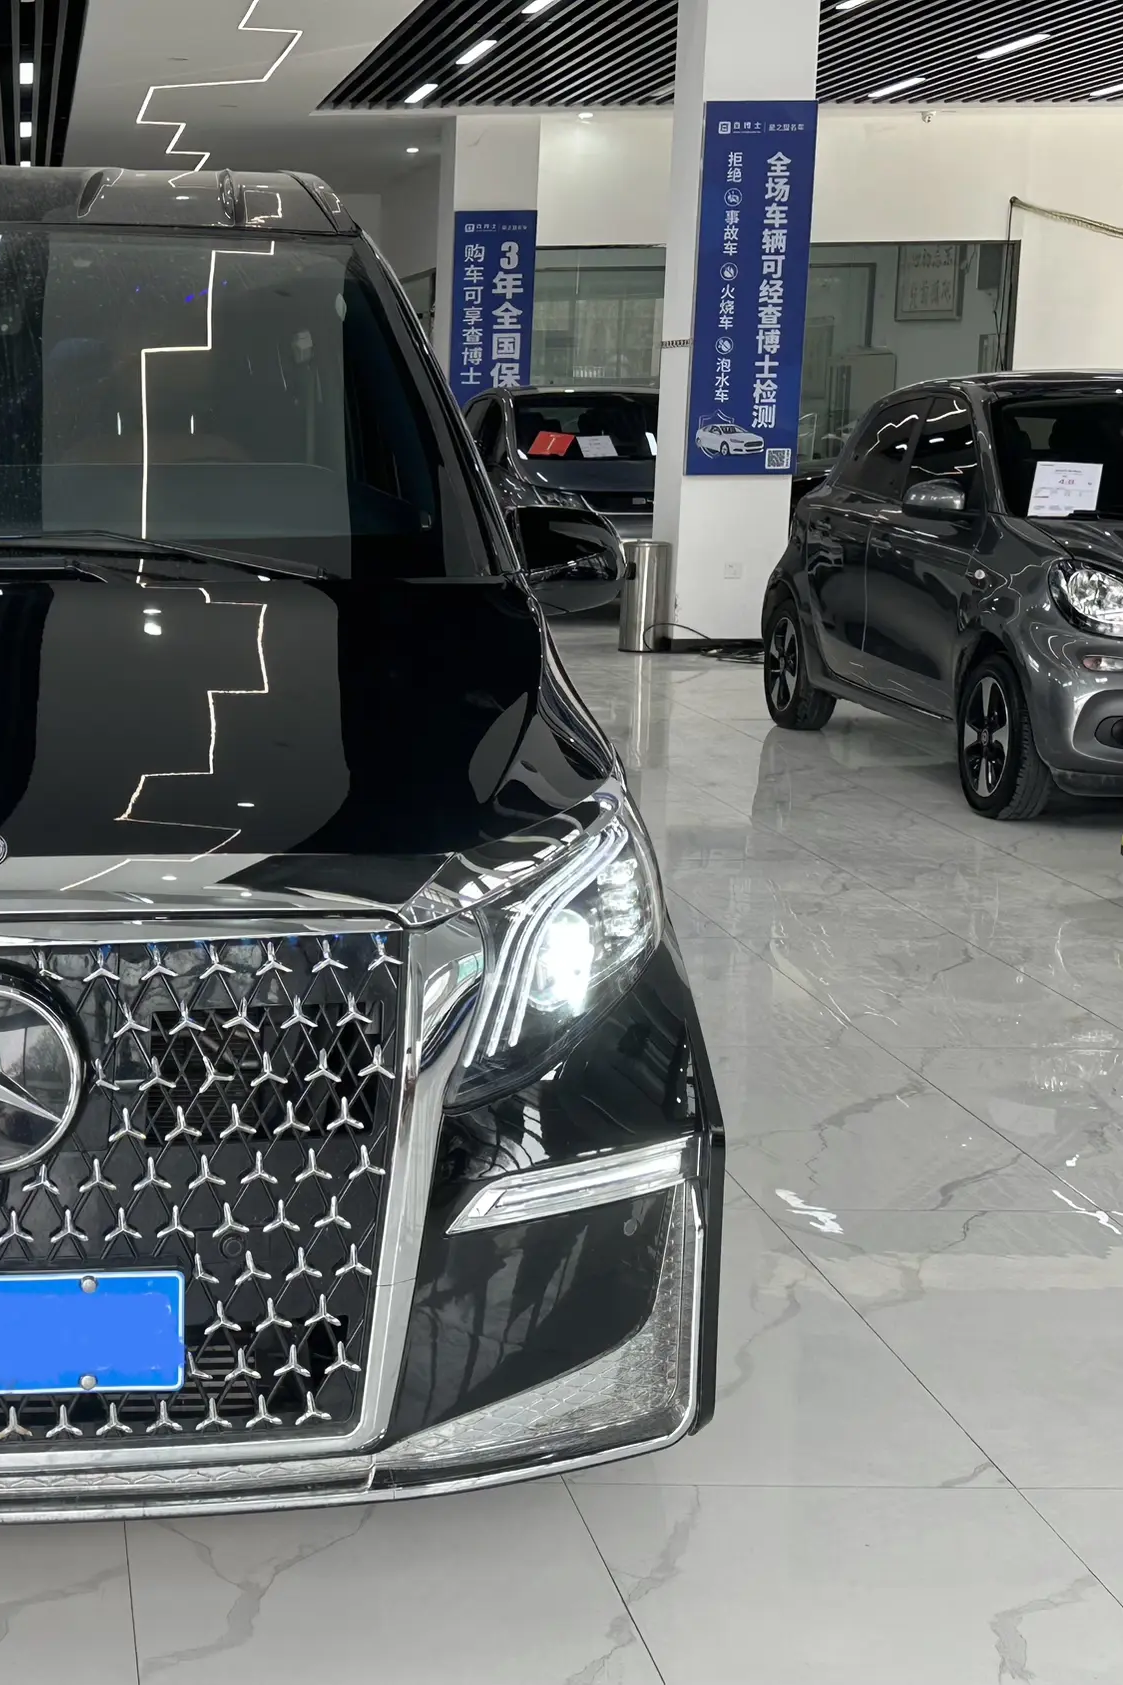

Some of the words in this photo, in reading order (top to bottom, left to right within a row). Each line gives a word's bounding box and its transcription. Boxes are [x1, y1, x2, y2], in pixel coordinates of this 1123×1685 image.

[727, 152, 743, 183] 拒绝
[722, 210, 740, 256] 事故车
[718, 284, 735, 330] 火烧车
[752, 151, 792, 429] 全场车辆可经查博士检测
[460, 243, 485, 385] 购车可享查博士
[714, 358, 731, 403] 泡水车
